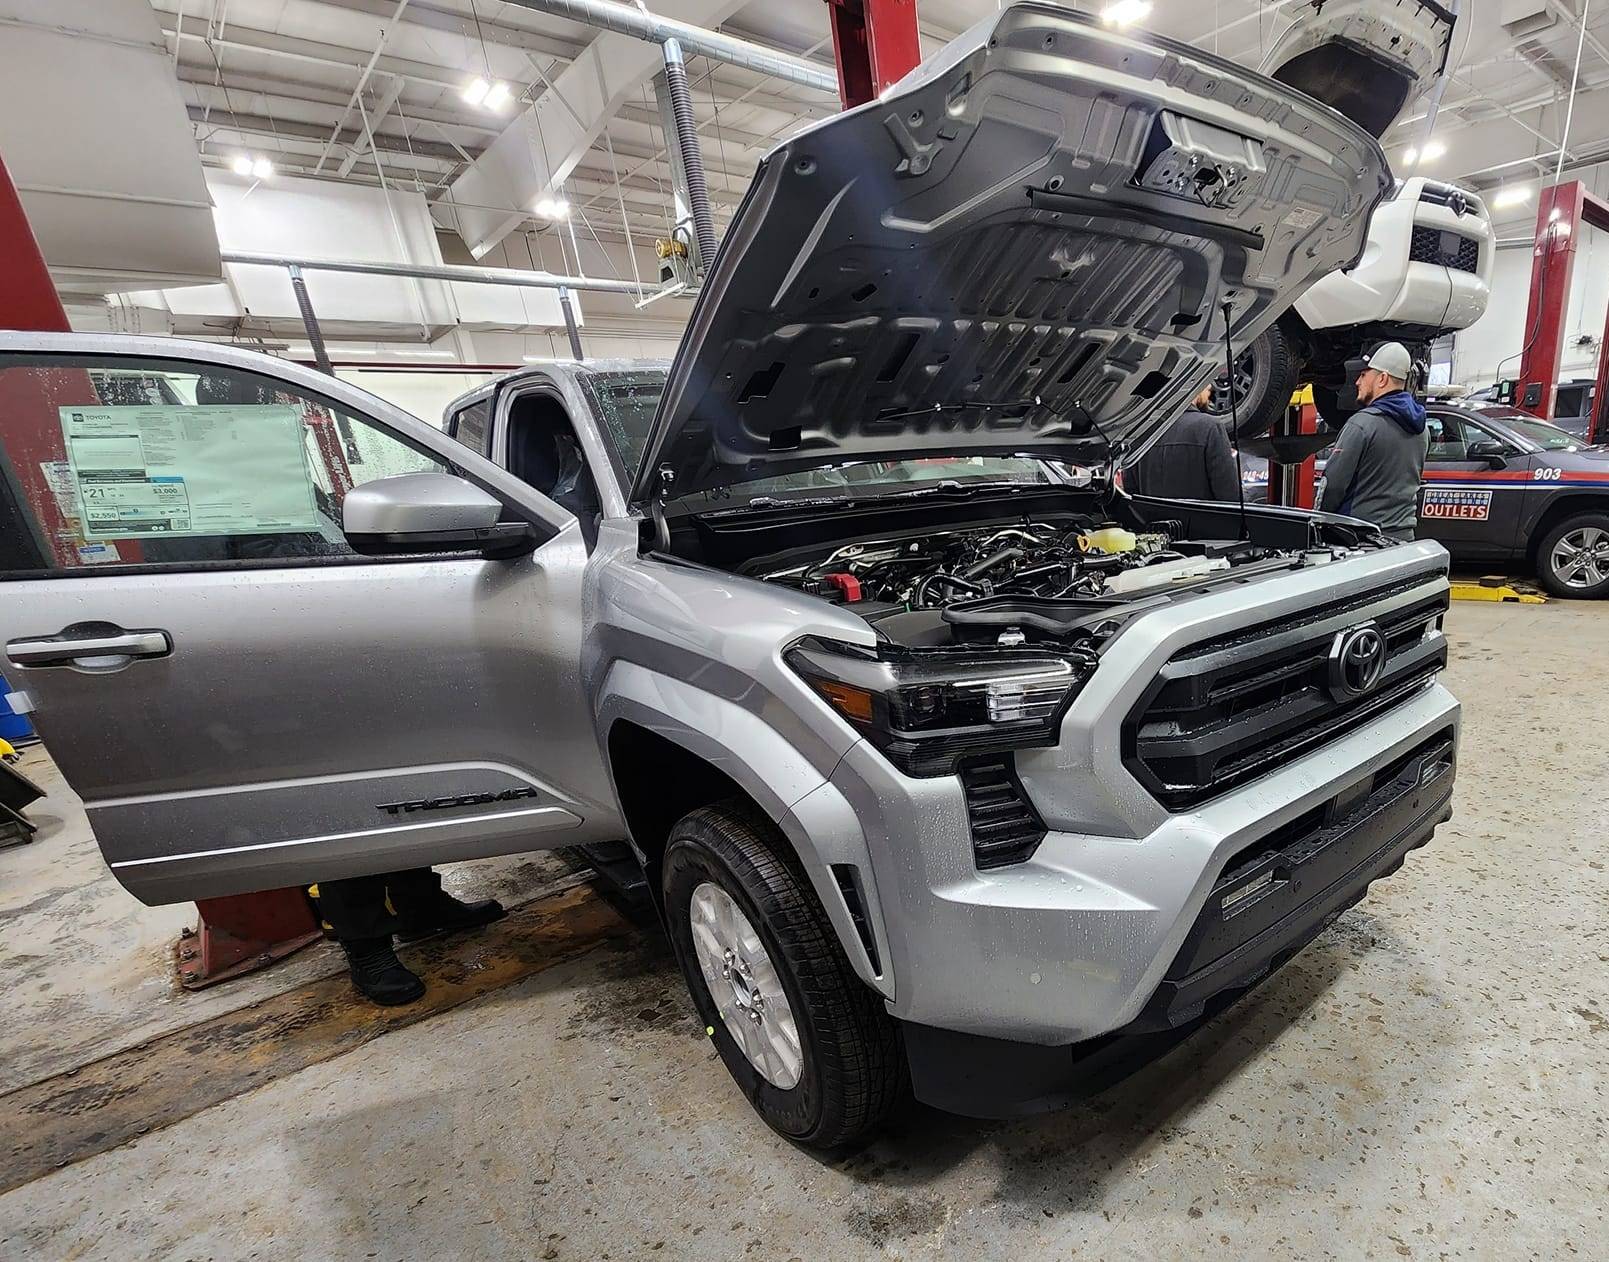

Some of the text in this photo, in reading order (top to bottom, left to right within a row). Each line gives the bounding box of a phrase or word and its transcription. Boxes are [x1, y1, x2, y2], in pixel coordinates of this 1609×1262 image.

[1533, 468, 1562, 481] 903
[89, 488, 105, 498] 21
[1424, 503, 1486, 518] OUTLETS
[375, 787, 538, 814] TACOMA
